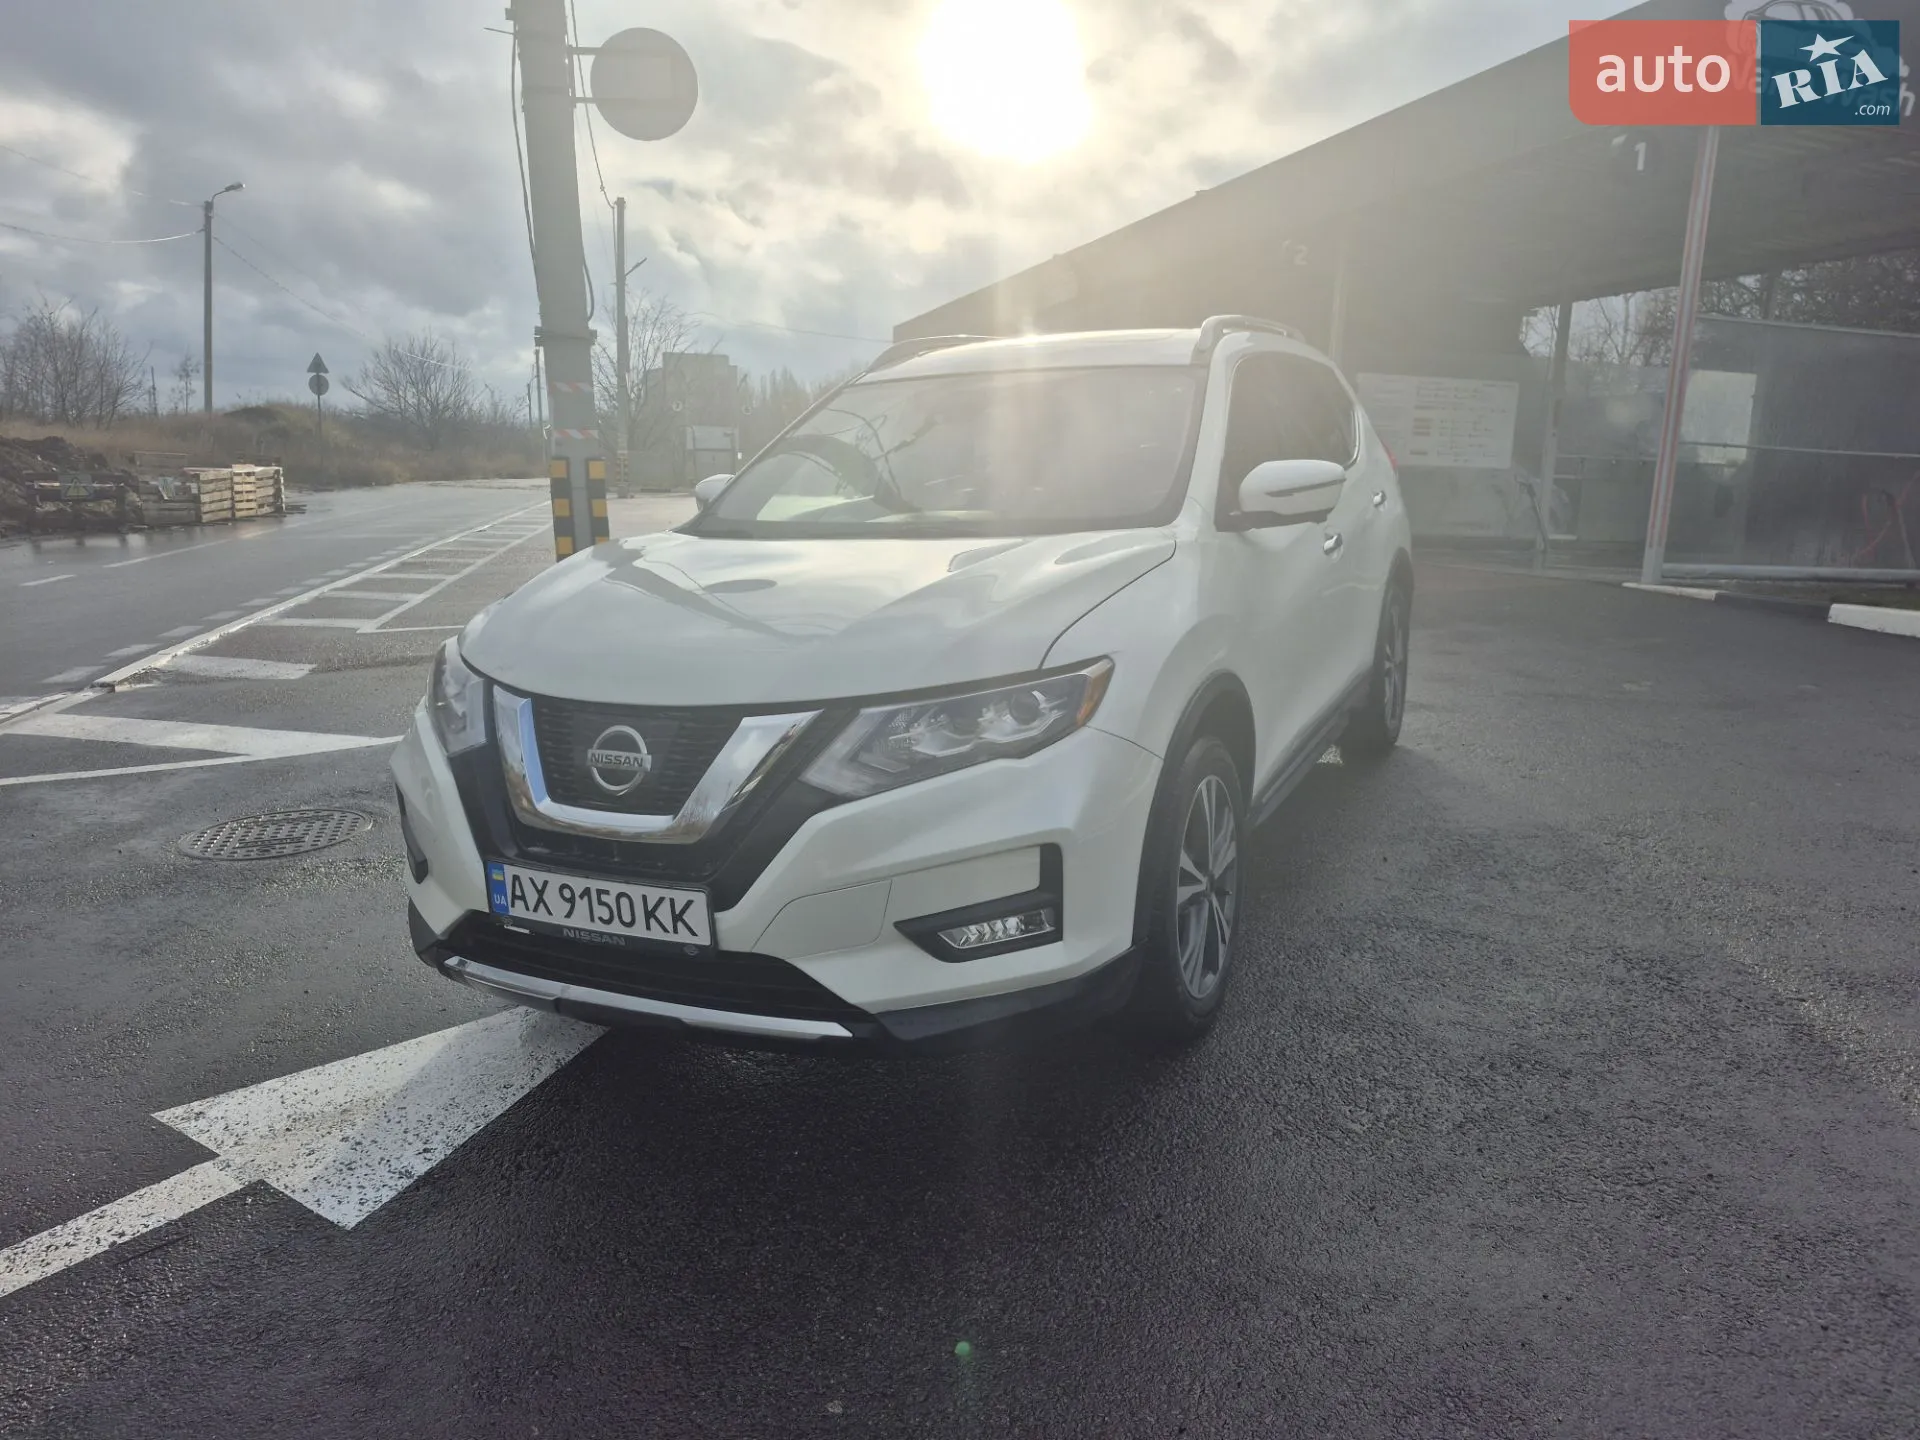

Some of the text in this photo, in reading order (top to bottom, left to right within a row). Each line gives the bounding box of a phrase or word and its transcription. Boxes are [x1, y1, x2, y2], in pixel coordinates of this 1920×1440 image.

[1634, 141, 1647, 171] 1
[590, 752, 644, 768] NISSAN
[494, 894, 508, 907] UA
[562, 926, 626, 947] NISSAN
